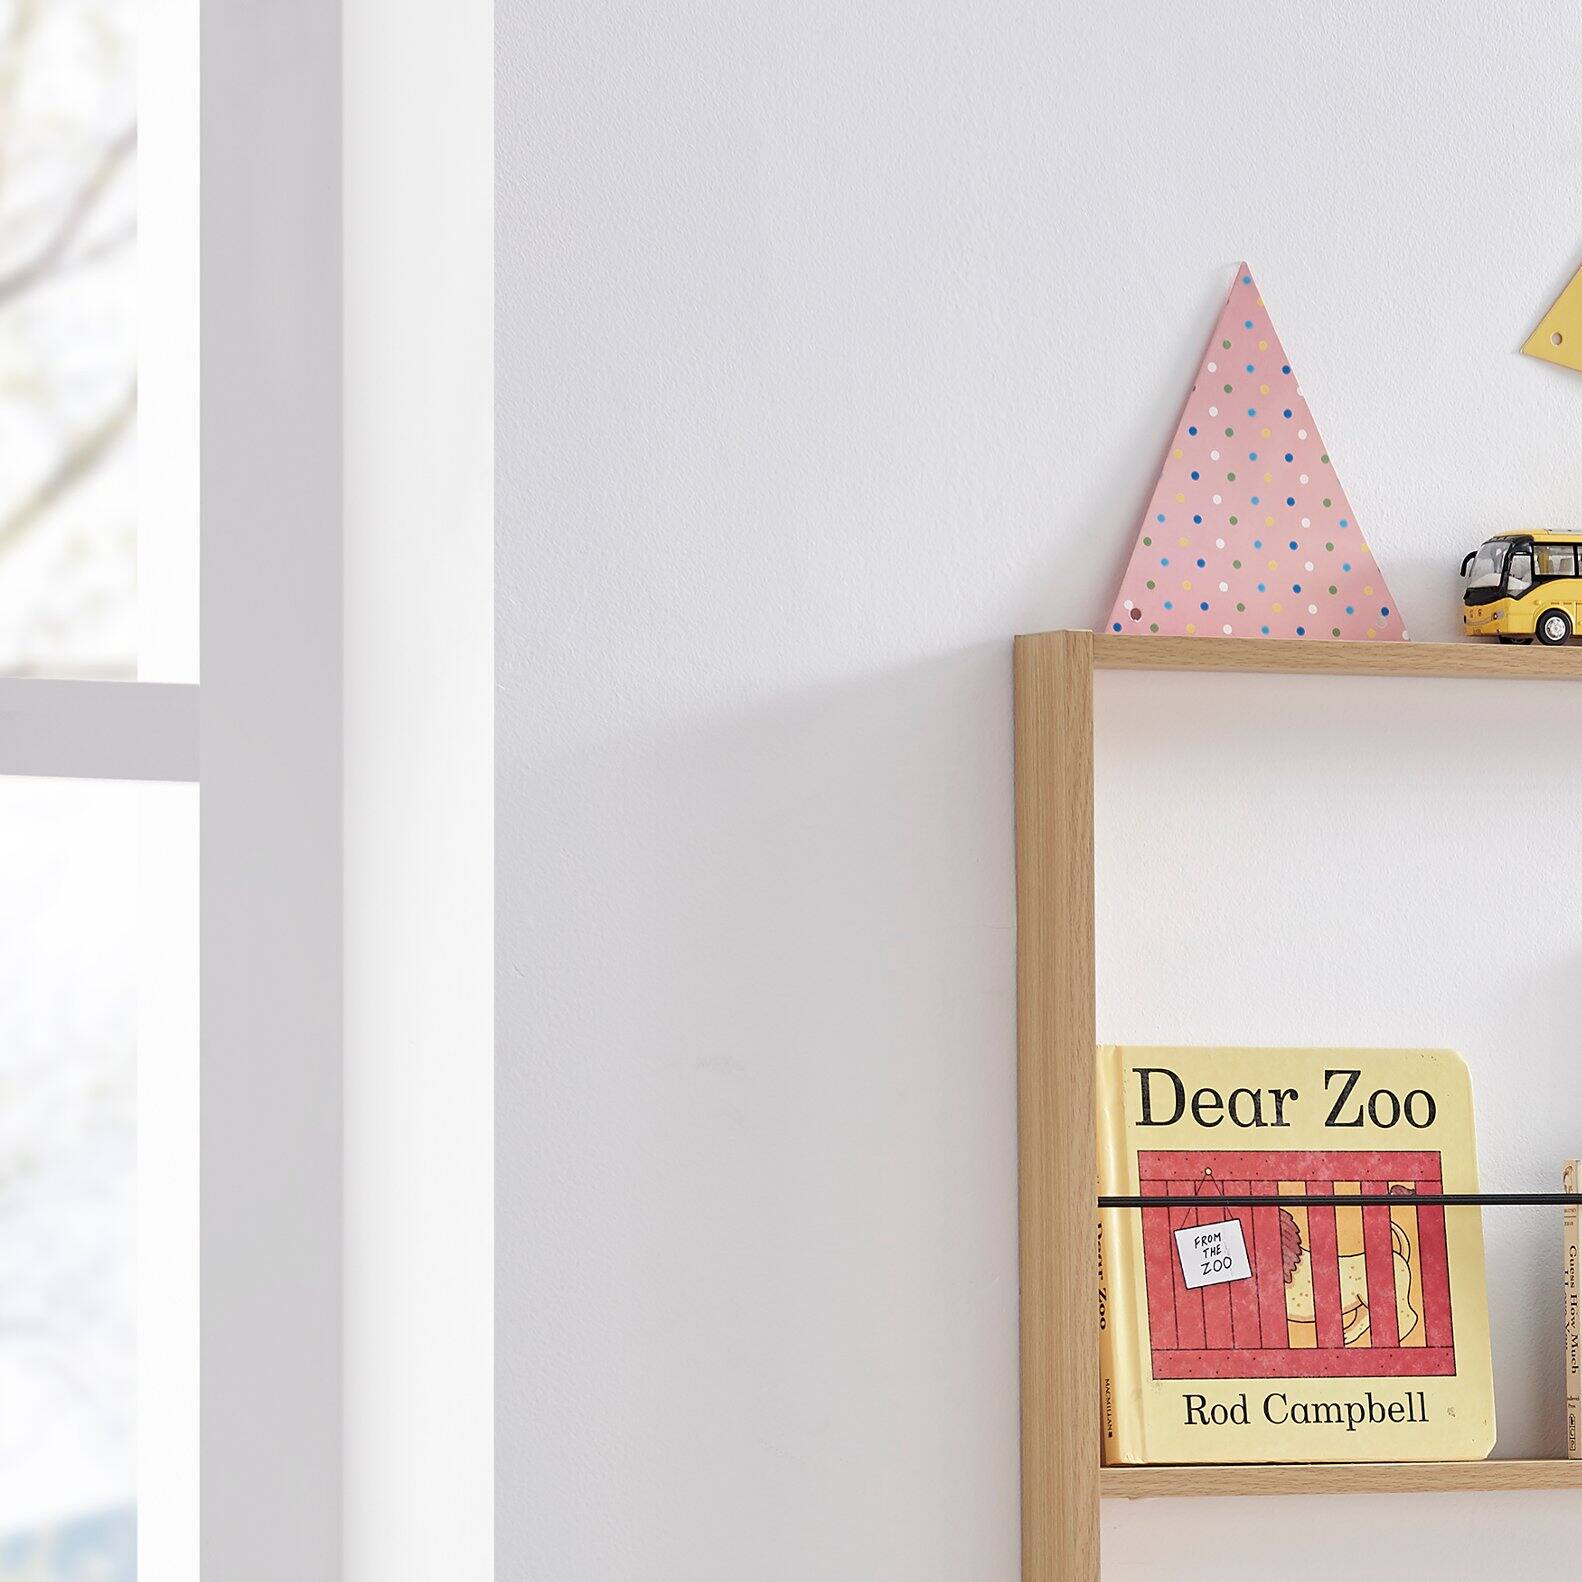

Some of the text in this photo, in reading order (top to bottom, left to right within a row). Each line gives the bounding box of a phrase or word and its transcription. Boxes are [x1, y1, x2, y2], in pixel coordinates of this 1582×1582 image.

[1132, 1067, 1437, 1129] Dear Zoo
[1194, 1232, 1222, 1249] FROM
[1203, 1244, 1222, 1258] THE
[1201, 1256, 1233, 1276] ZOO
[1569, 1245, 1579, 1374] Guess How Much
[1183, 1391, 1430, 1431] Rod Campbell
